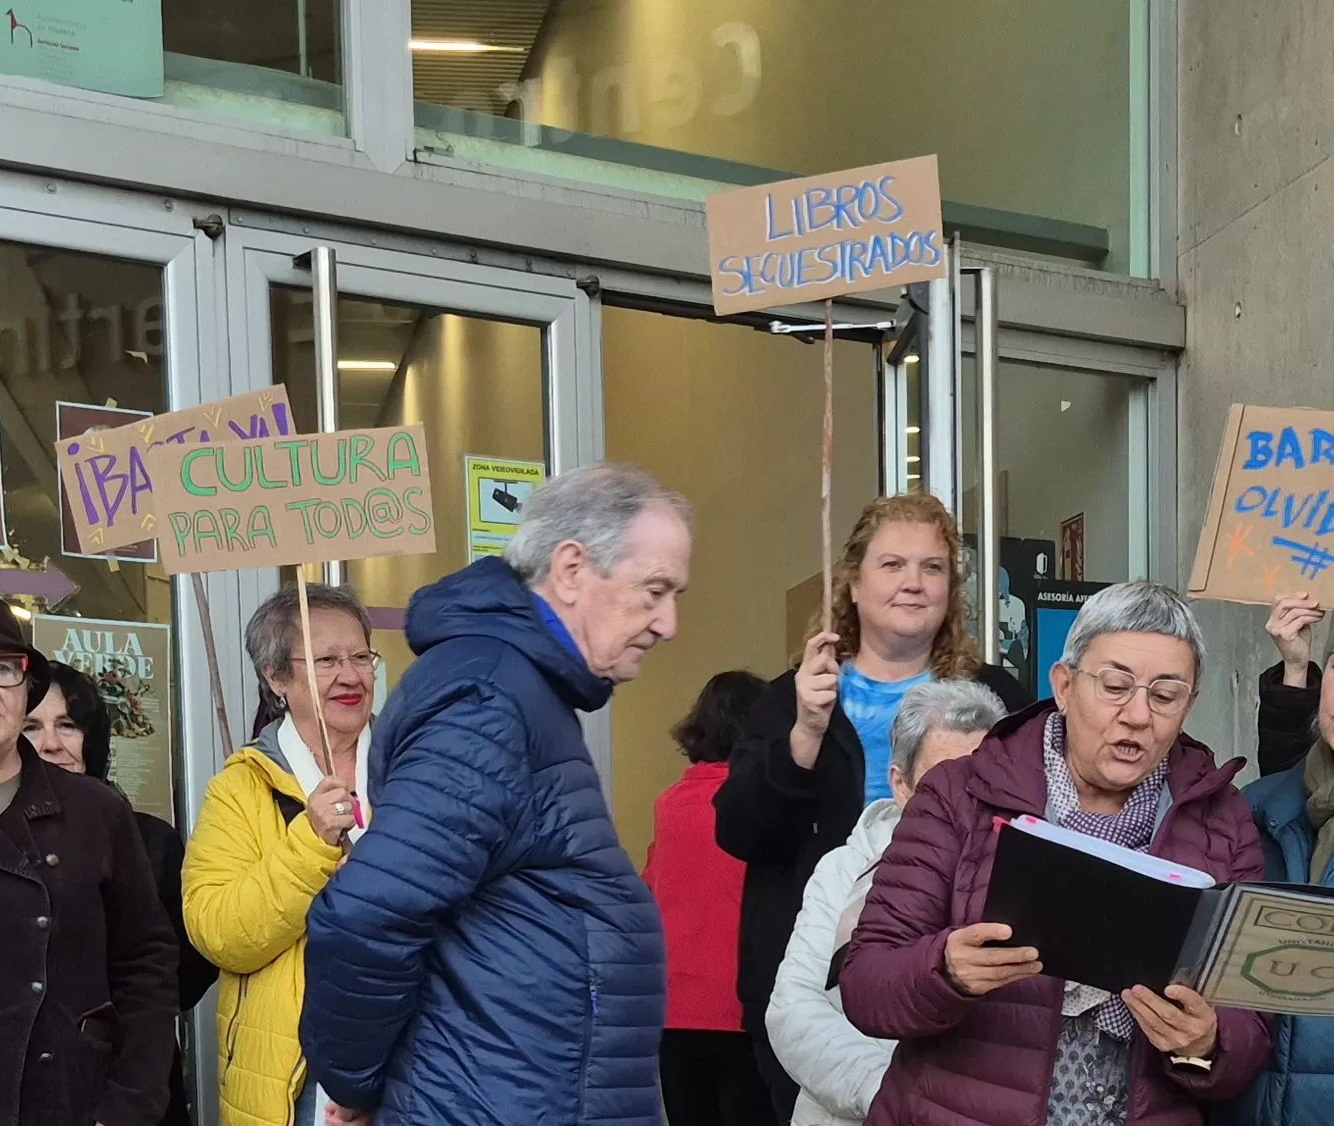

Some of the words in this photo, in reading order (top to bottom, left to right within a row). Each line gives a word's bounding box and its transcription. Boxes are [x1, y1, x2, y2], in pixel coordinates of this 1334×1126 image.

[765, 176, 903, 243] LIBROS
[718, 229, 942, 297] SECUESTRADOS
[179, 432, 421, 497] CULTURA
[472, 463, 490, 472] ZONA
[492, 465, 540, 477] VIDEOVIGILADA
[168, 505, 277, 557] PARA
[285, 488, 431, 545] TOD@S
[1037, 591, 1074, 604] ASESORÍA
[61, 628, 144, 657] AULA
